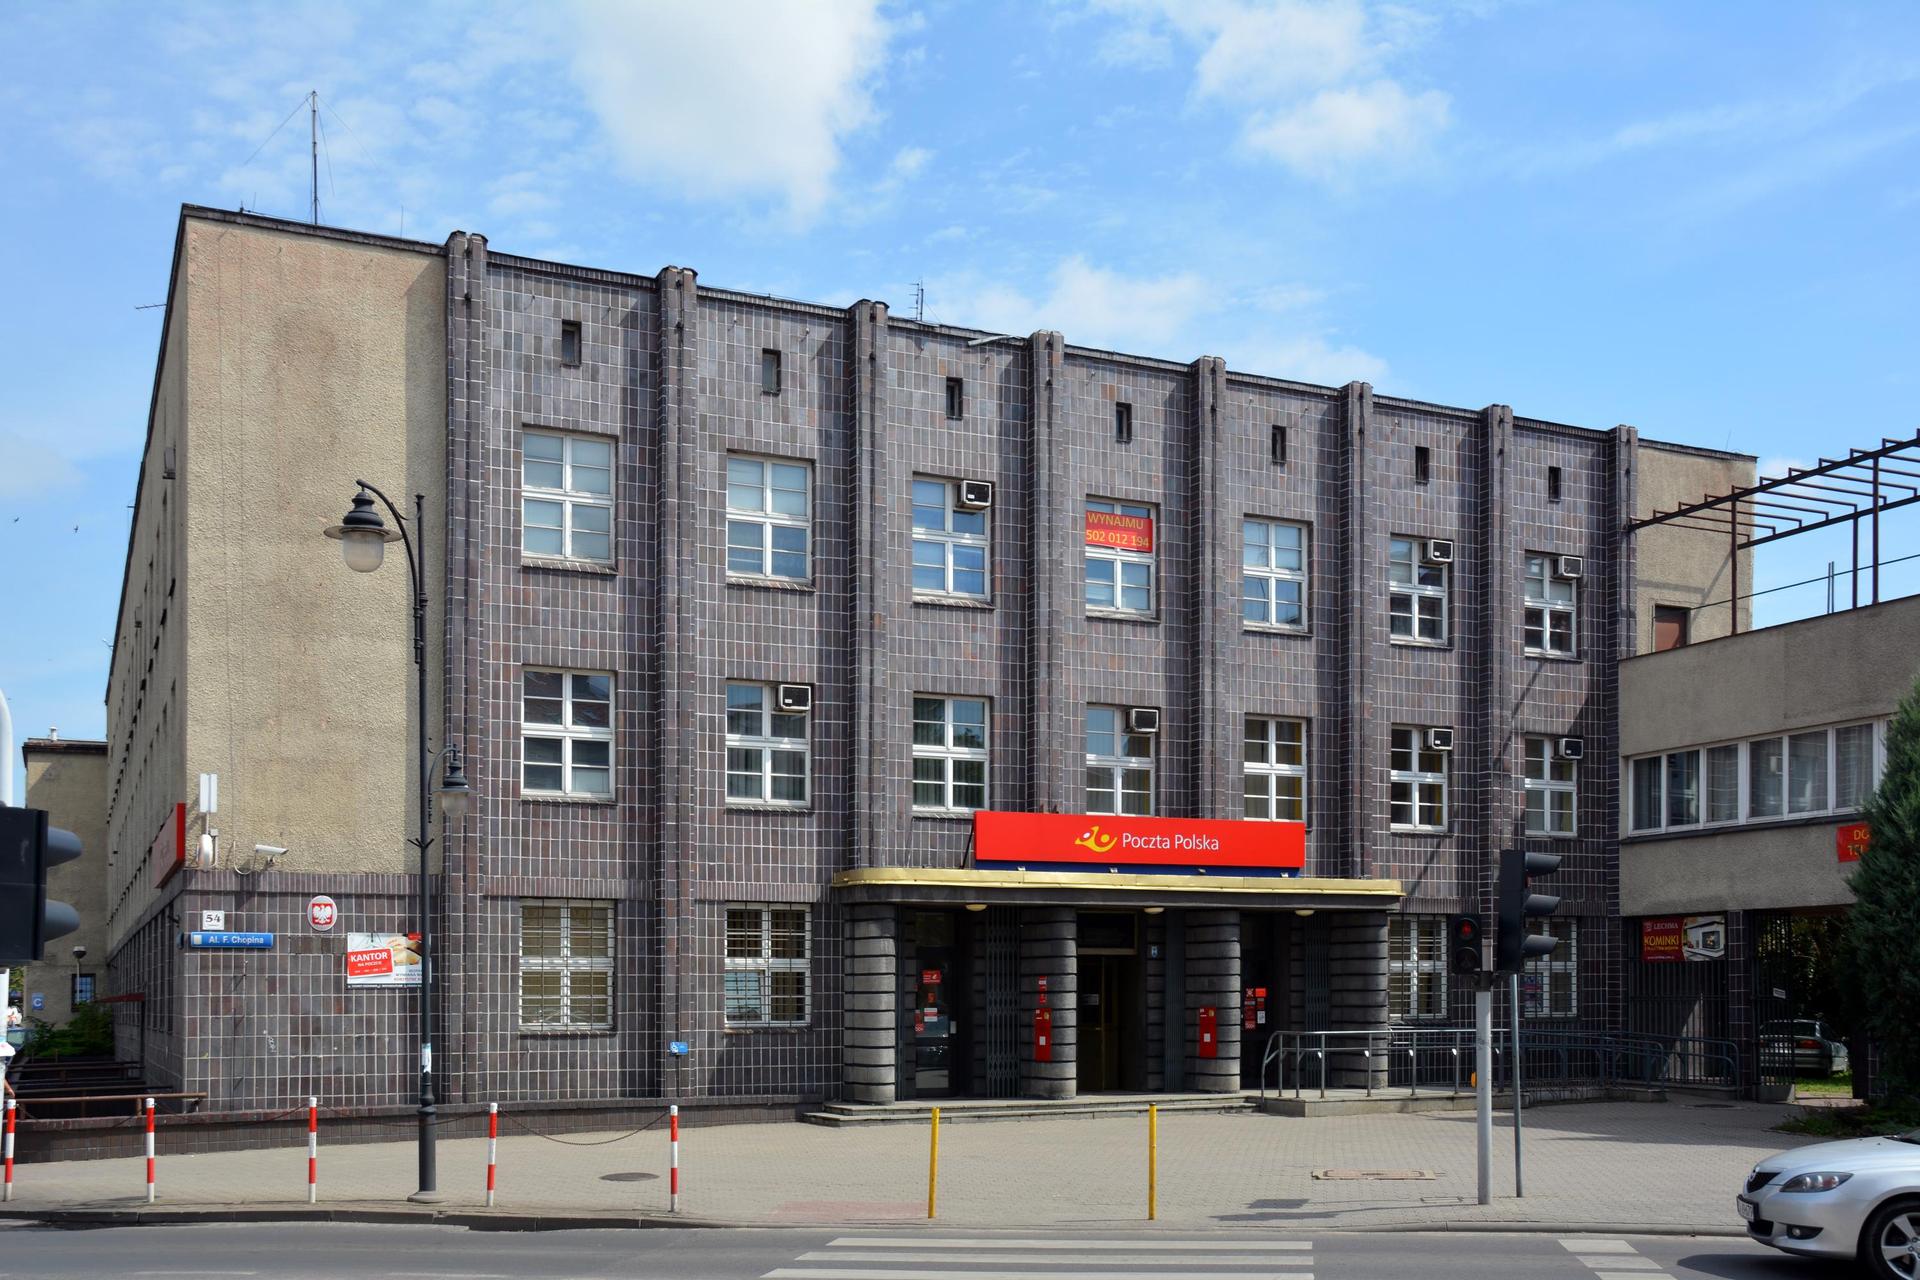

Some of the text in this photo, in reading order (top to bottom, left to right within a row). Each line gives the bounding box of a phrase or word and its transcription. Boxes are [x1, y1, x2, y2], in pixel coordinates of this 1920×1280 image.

[1087, 512, 1144, 529] WYNAJMU
[1086, 529, 1149, 549] 502 012 194
[1122, 832, 1219, 850] Poczta Polska
[205, 914, 221, 923] 54
[208, 935, 264, 945] Al. F. Chopina
[1643, 935, 1680, 946] KOMINKI
[350, 951, 388, 963] KANTOR
